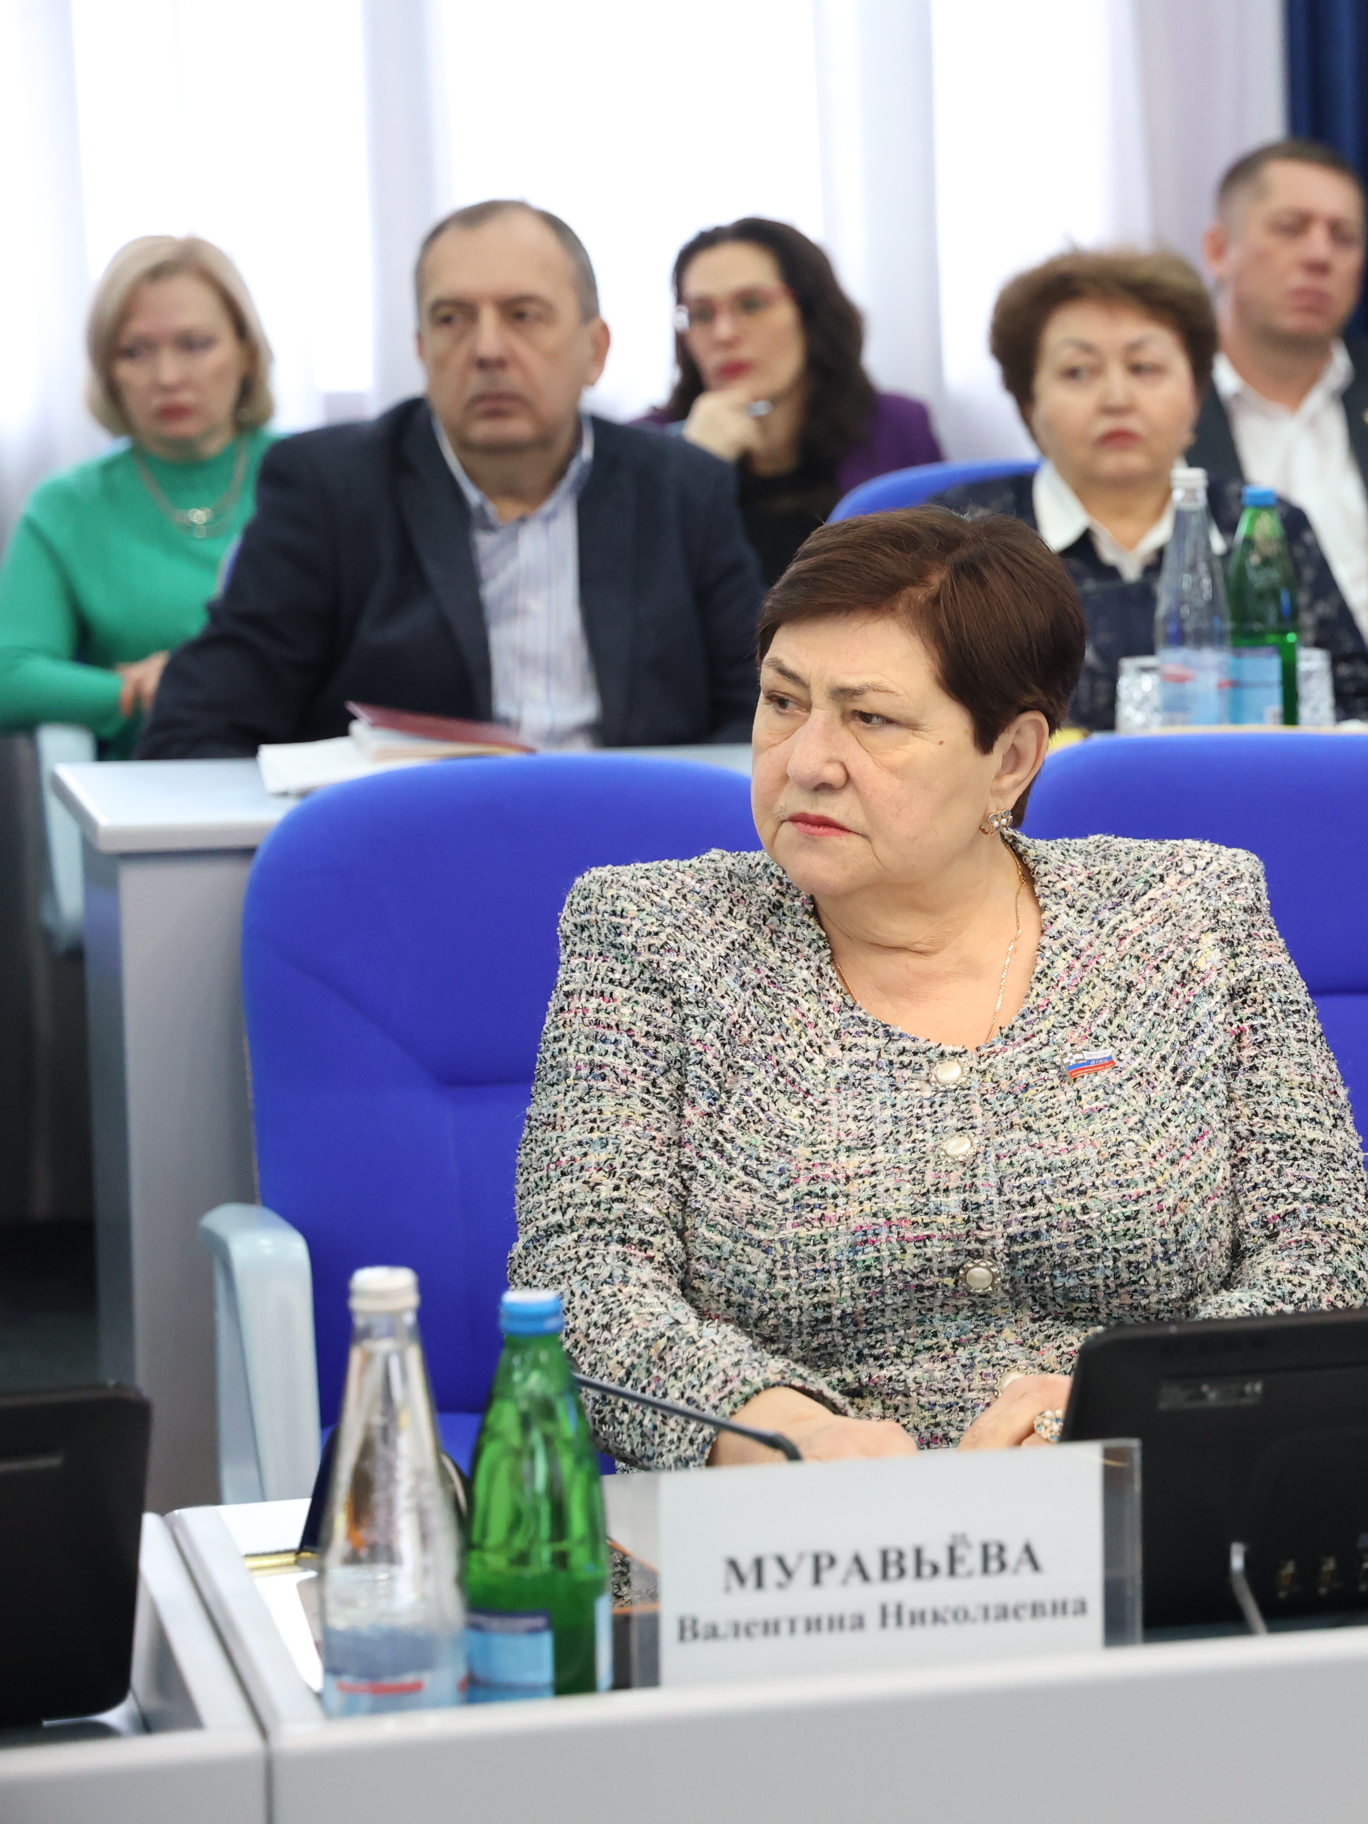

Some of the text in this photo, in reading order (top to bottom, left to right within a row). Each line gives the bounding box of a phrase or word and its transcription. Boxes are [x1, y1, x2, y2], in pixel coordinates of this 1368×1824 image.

[724, 1532, 1042, 1593] МУРАВЬЁВА
[676, 1597, 1088, 1644] Валентина Николаевна
